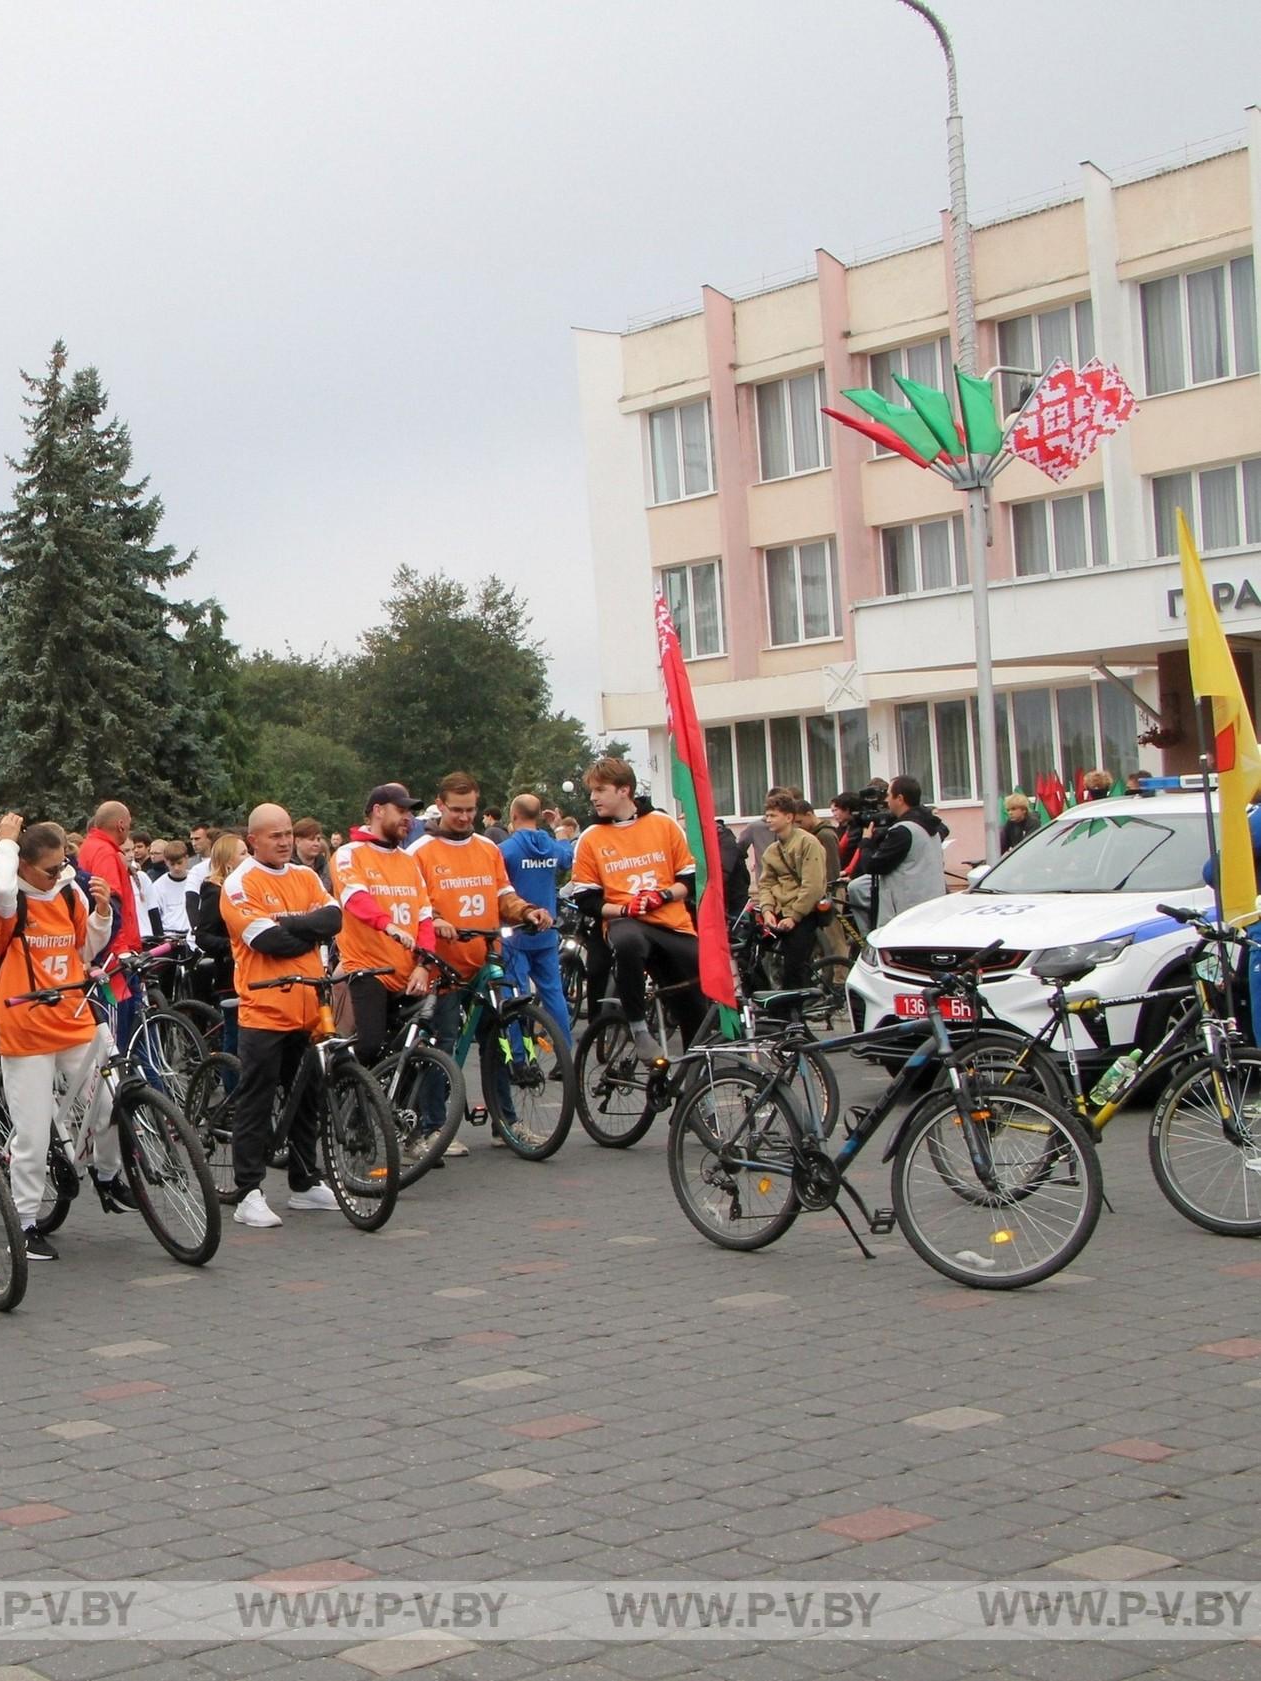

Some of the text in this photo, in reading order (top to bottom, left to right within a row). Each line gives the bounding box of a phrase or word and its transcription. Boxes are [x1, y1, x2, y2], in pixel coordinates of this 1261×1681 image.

[604, 854, 652, 873] СТРОЙТРЕСТ
[626, 870, 658, 895] 25
[390, 902, 411, 925] 16
[458, 893, 486, 918] 29
[24, 934, 72, 949] ТРОЙТРЕСТ
[41, 955, 69, 981] 15
